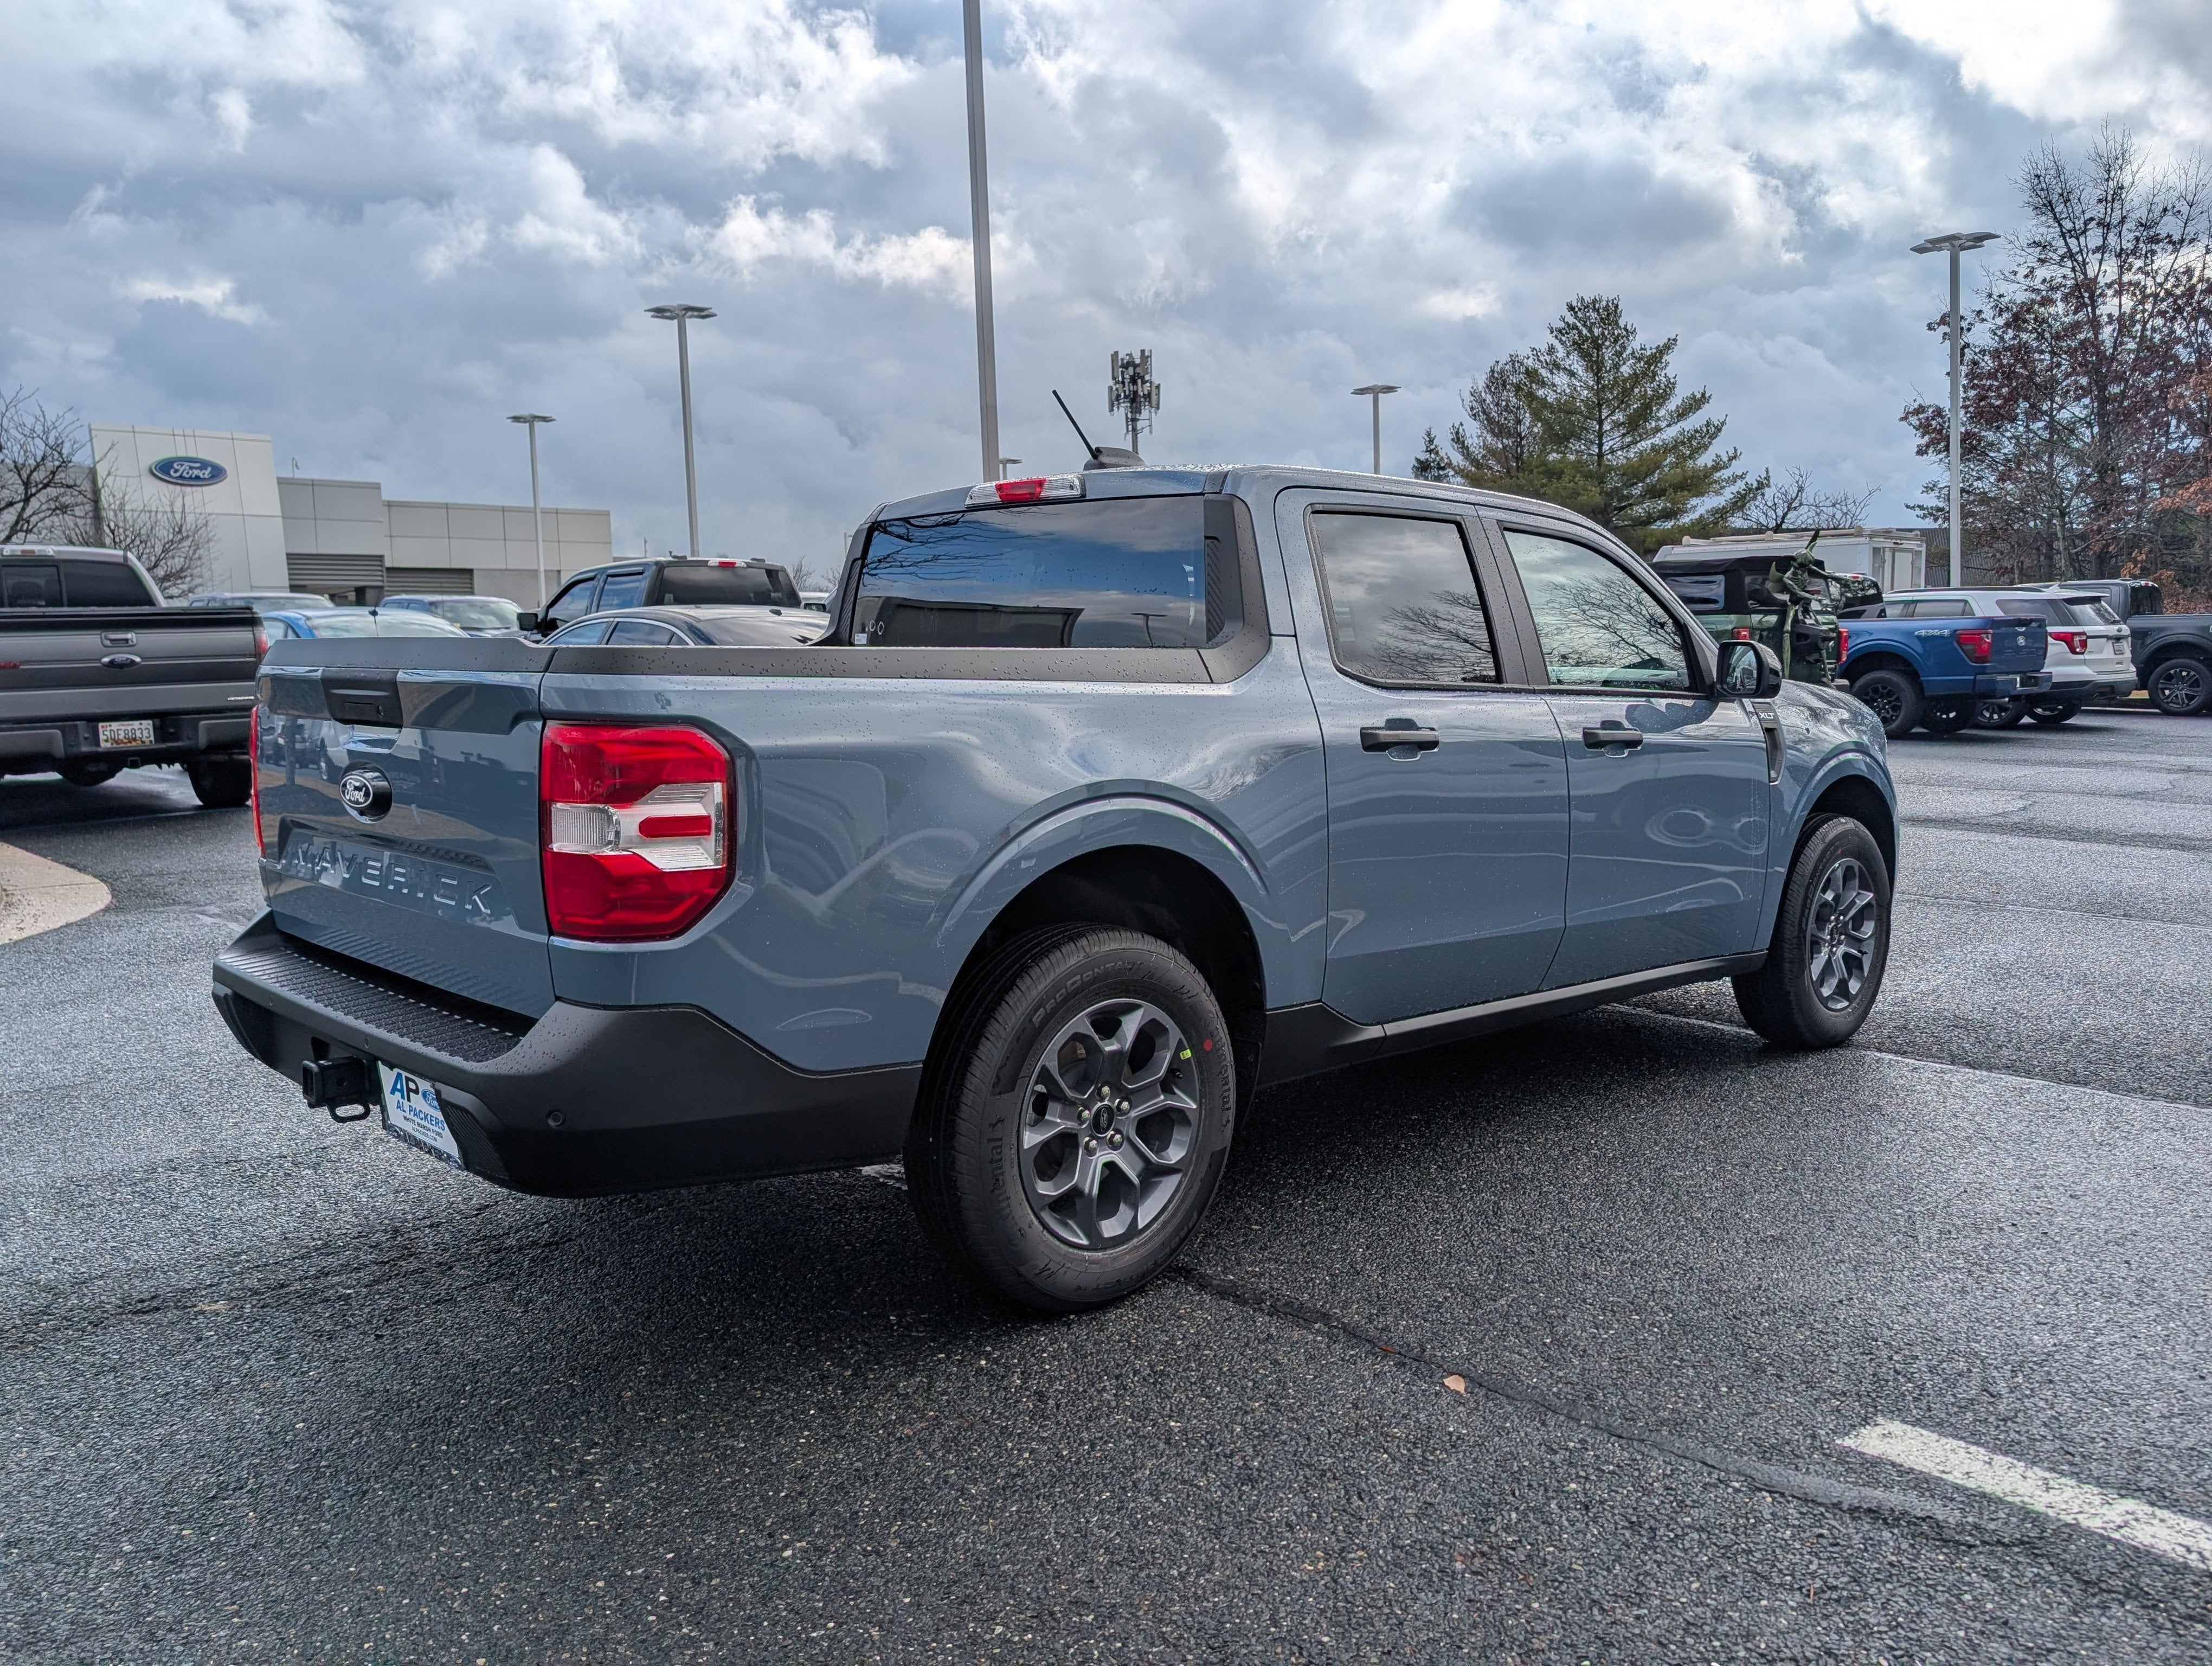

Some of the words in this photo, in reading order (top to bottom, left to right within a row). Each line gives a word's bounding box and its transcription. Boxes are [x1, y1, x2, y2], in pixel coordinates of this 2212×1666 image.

[170, 461, 211, 478] Ford
[345, 779, 365, 803] Ford
[292, 843, 492, 915] MAVERICK
[390, 1072, 420, 1104] AP
[396, 1099, 407, 1113] AL
[408, 1105, 445, 1131] PACKERS
